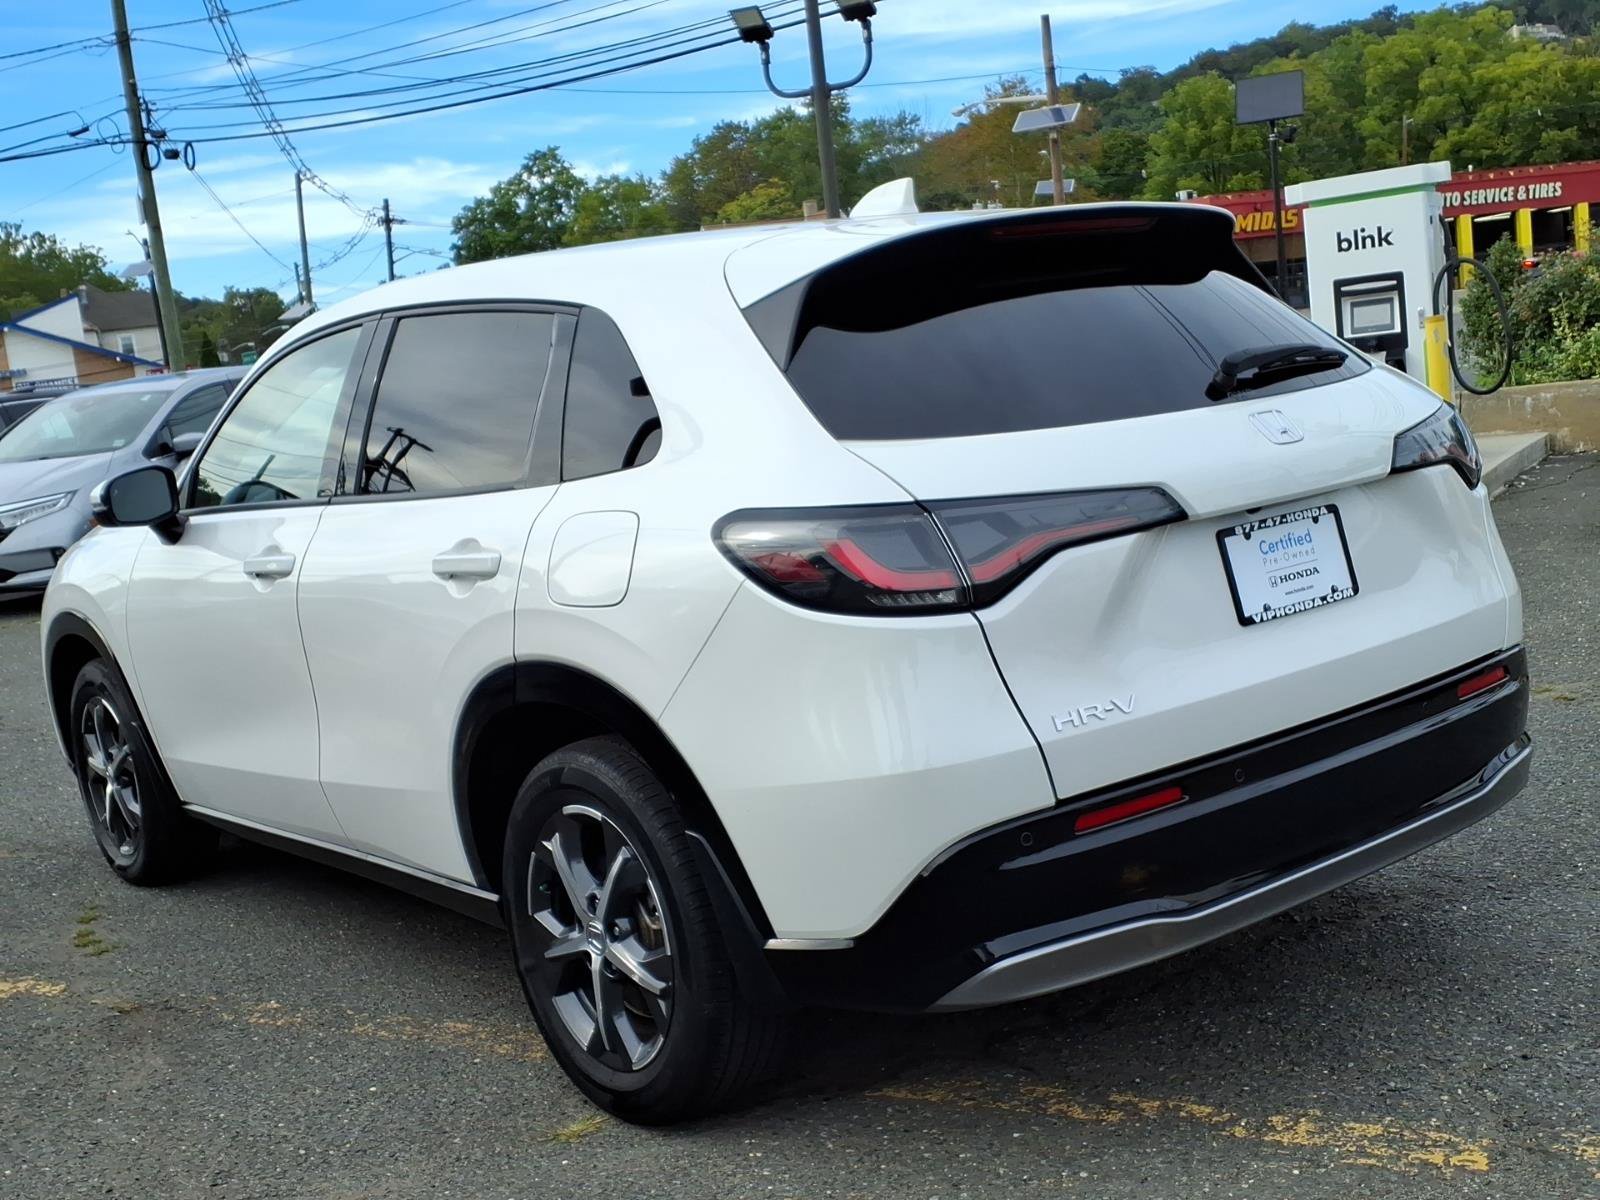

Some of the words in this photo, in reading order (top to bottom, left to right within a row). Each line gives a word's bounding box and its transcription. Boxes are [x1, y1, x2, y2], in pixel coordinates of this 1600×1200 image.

[1463, 186, 1514, 206] SERVICE
[1528, 182, 1562, 198] TIRES
[1336, 225, 1394, 253] blink
[1234, 506, 1328, 535] 877-47-HONDA
[1259, 528, 1313, 555] Certified
[1262, 547, 1315, 567] Pre-Owned
[1279, 566, 1320, 584] HONDA
[1252, 588, 1354, 623] VIPHONDA.COM
[1051, 693, 1136, 733] HR-V
